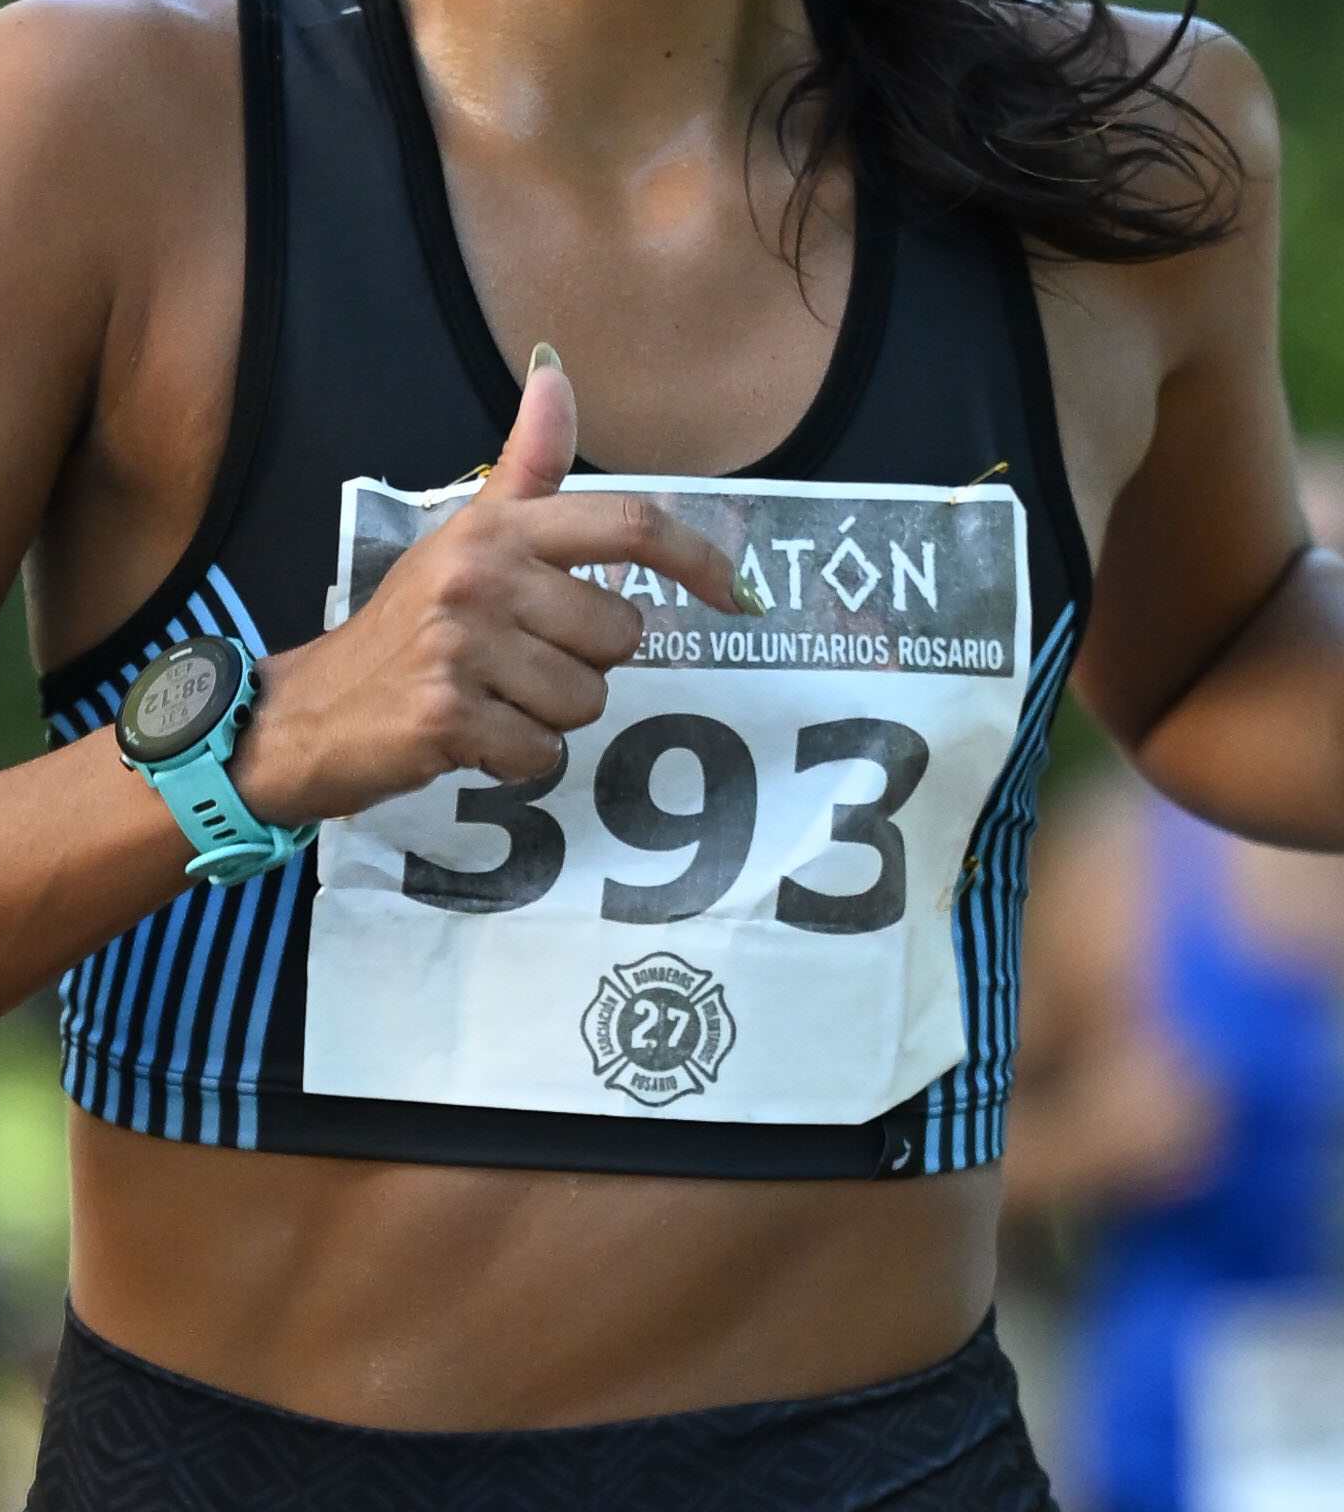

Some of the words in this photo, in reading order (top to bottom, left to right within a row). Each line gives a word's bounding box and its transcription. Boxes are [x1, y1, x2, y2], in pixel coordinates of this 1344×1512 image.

[569, 515, 938, 612] AATÓN
[633, 630, 702, 661] EROS
[710, 631, 891, 665] VOLUNTARIOS
[898, 637, 1004, 670] ROSARIO
[402, 712, 930, 936] 393
[631, 999, 691, 1049] 27
